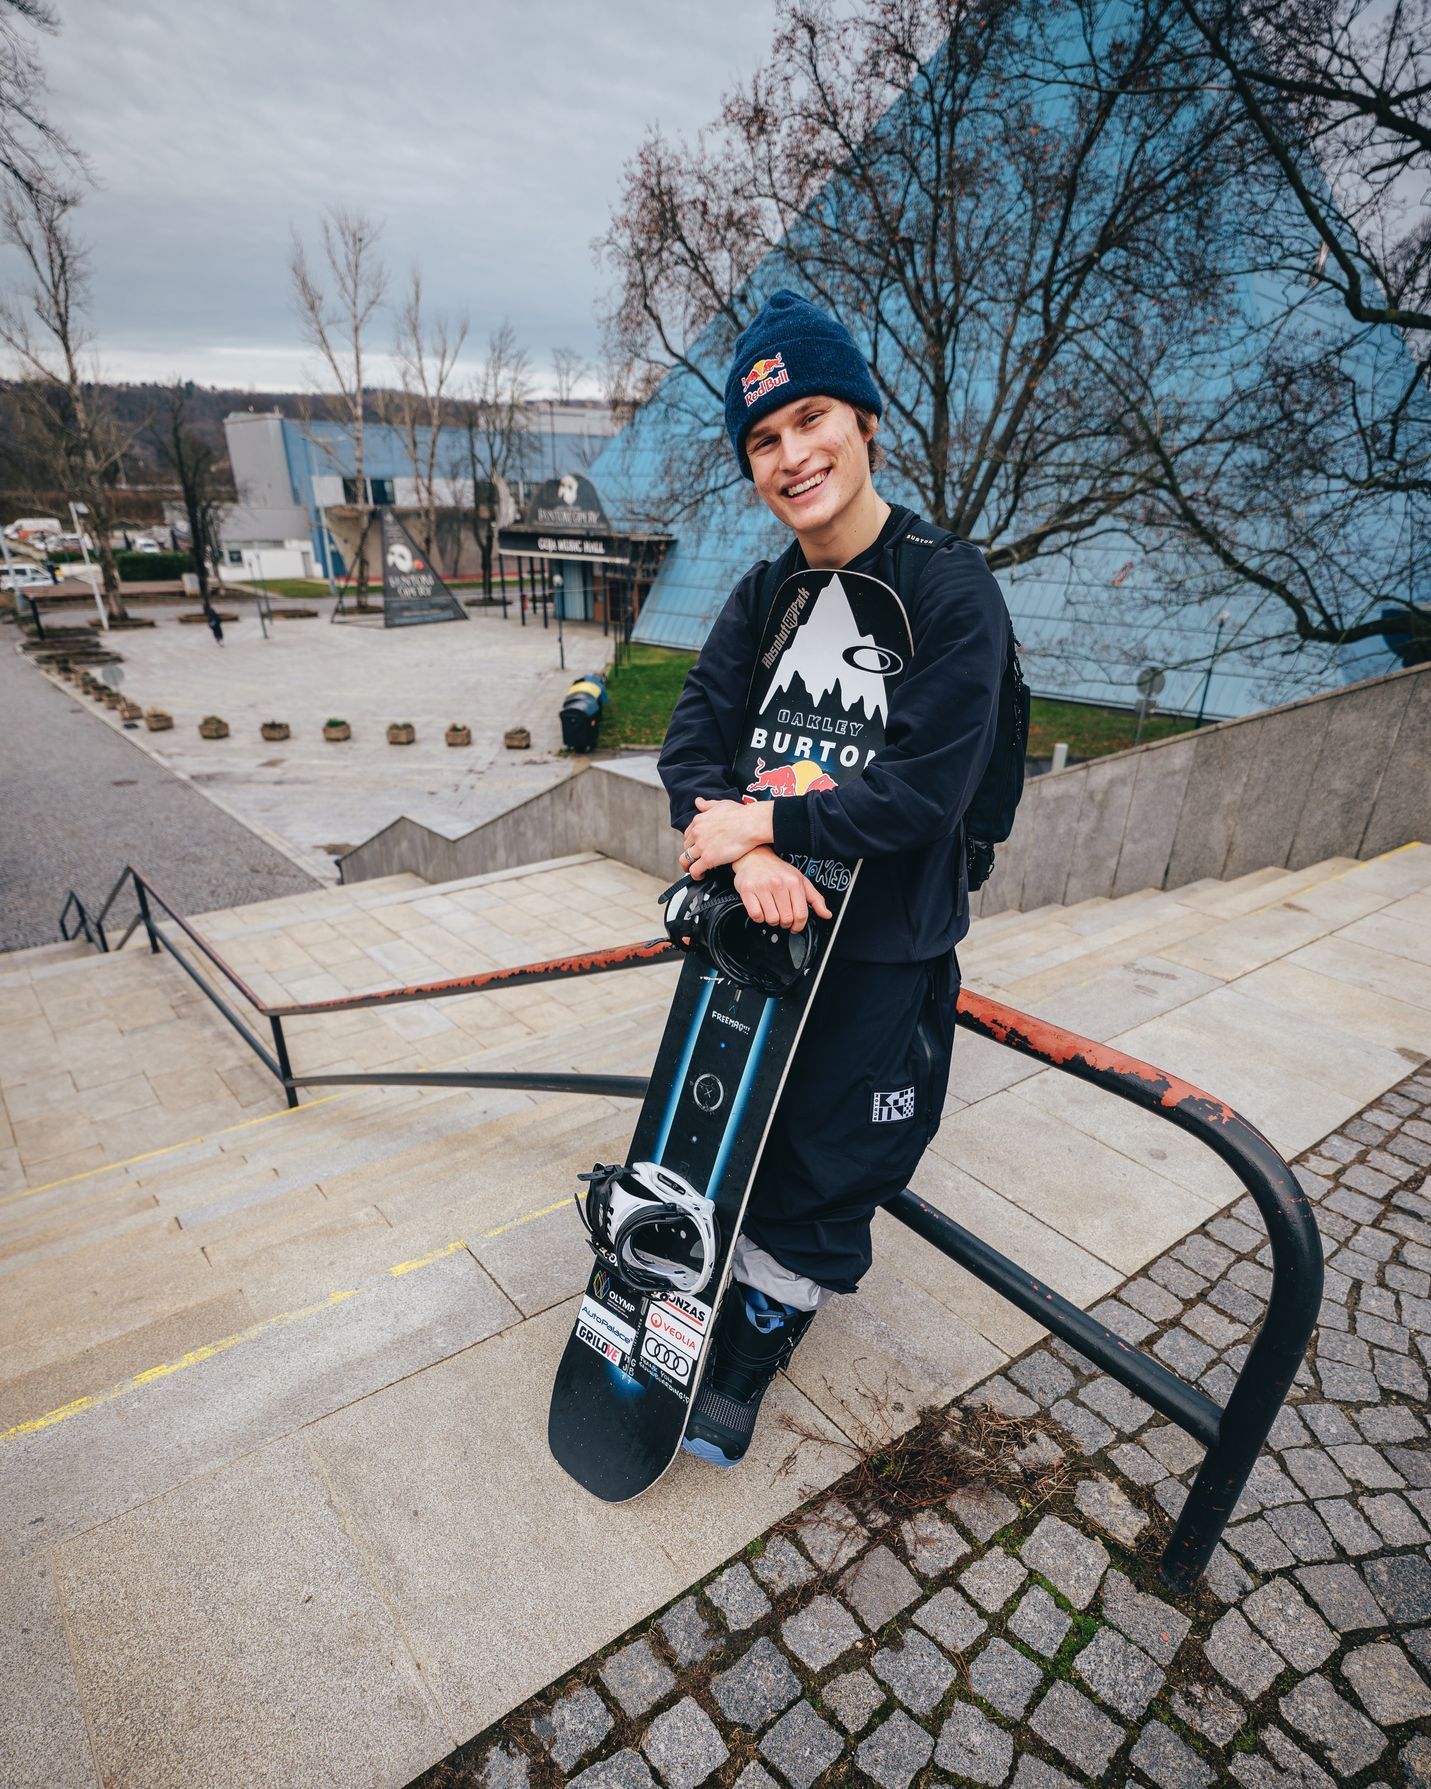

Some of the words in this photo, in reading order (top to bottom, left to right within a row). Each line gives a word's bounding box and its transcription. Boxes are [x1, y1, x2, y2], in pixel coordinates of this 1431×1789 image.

[745, 380, 766, 407] Red
[765, 369, 790, 392] Bull
[906, 534, 934, 545] BURTON
[777, 709, 864, 737] OAKLEY
[608, 1290, 636, 1312] OLYMP
[579, 1325, 620, 1363] GRILOVE
[663, 1322, 696, 1351] VEOLIA
